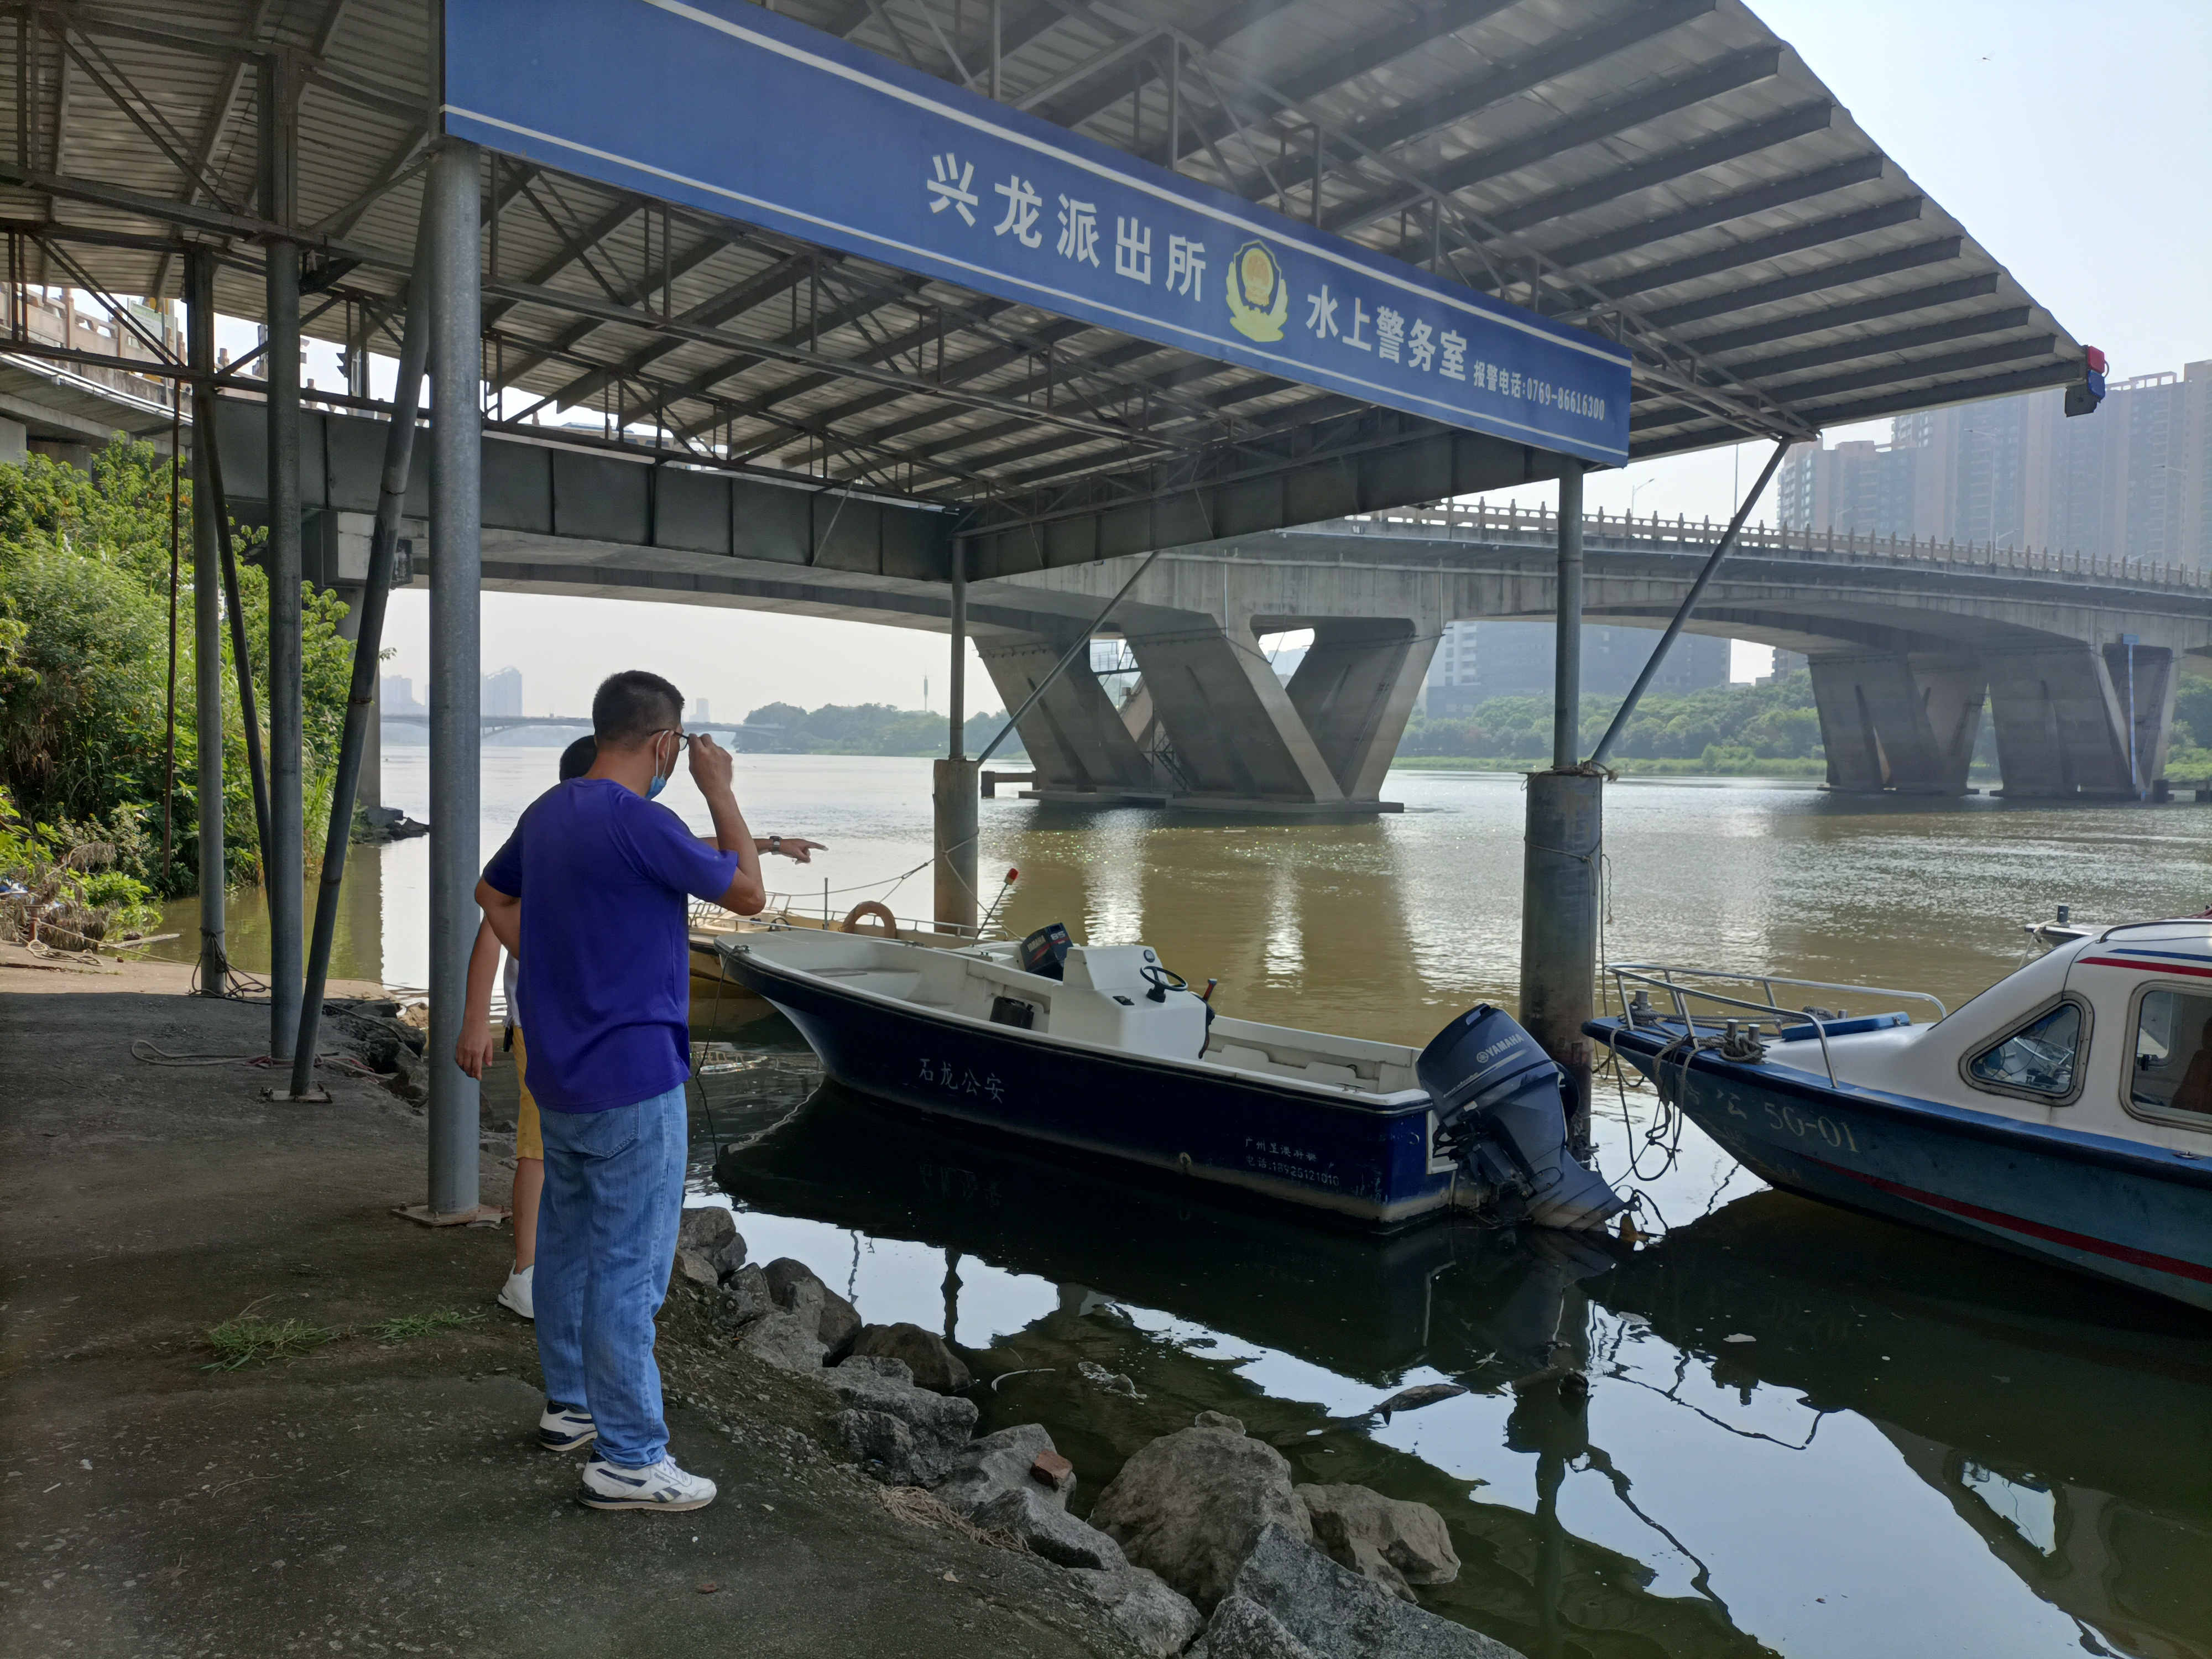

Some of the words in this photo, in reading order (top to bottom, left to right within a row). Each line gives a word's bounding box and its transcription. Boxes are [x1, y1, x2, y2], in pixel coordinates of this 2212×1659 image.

[927, 153, 1207, 302] 兴龙派出所
[1306, 284, 1467, 382] 水上警务室
[1485, 1034, 1525, 1057] YAMAHA
[919, 1058, 1005, 1104] 石龙公安
